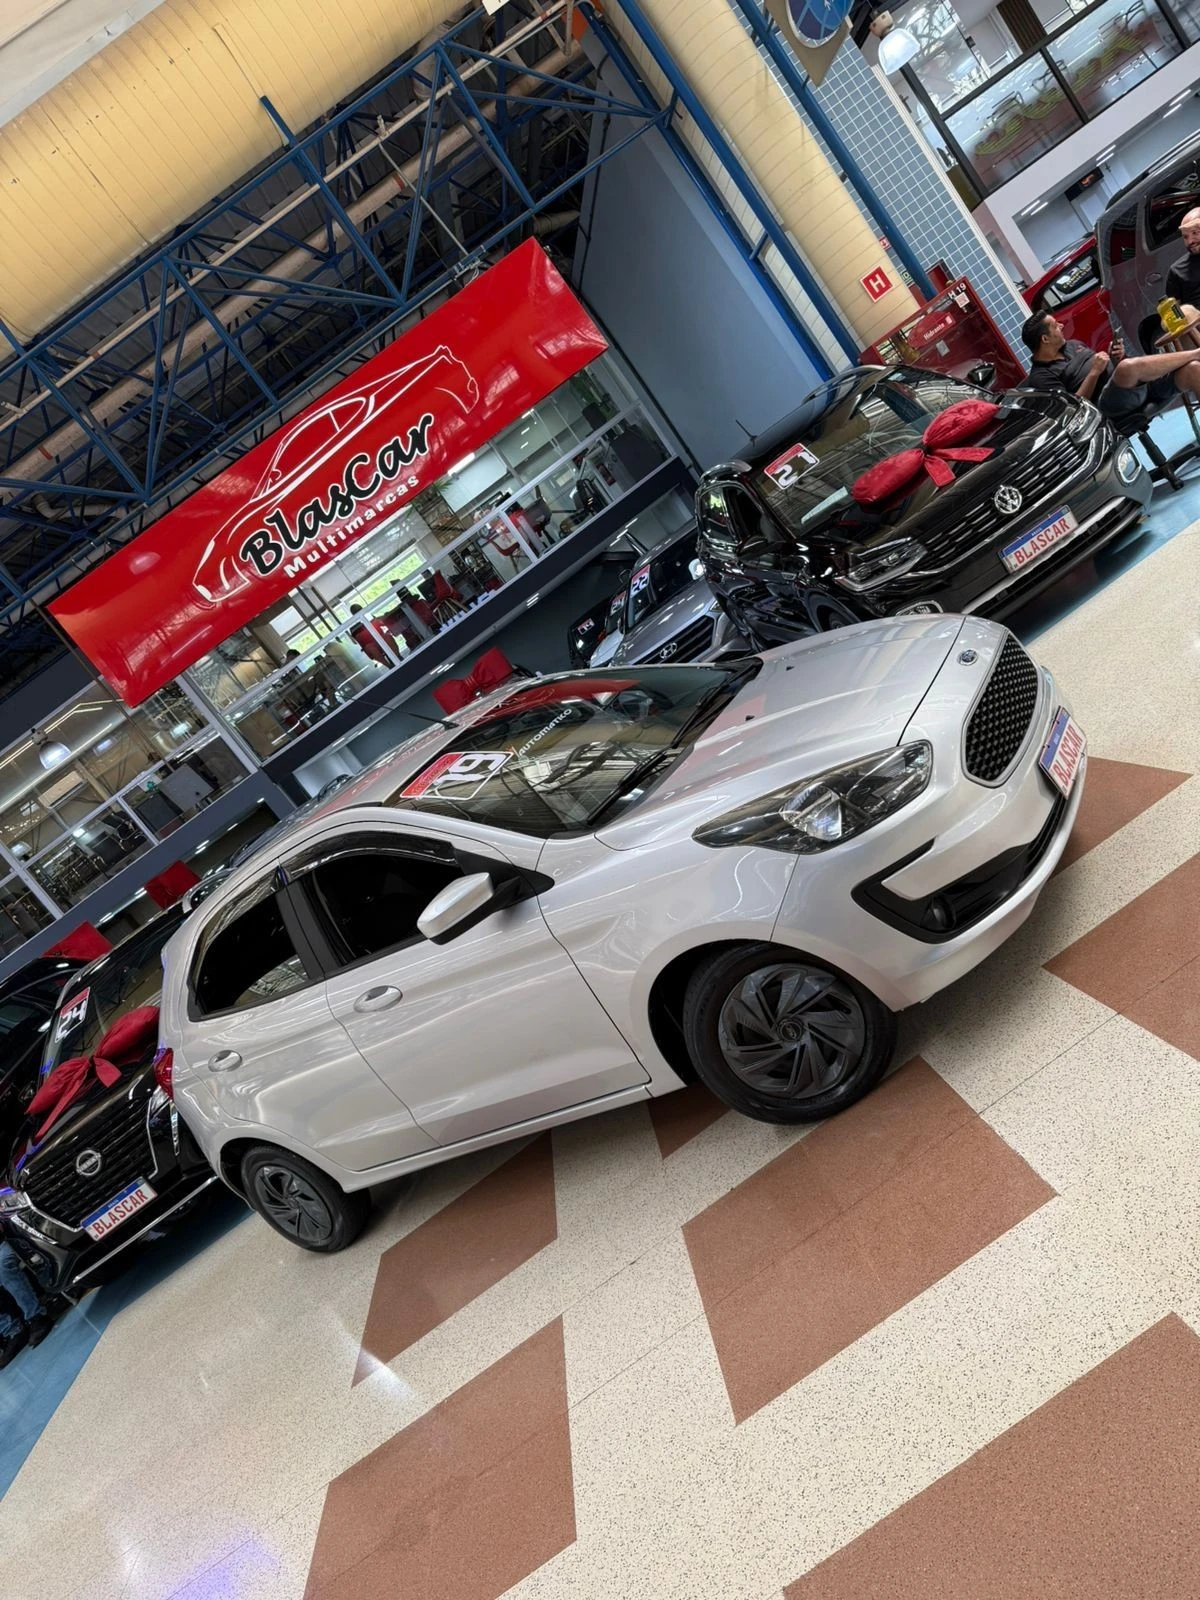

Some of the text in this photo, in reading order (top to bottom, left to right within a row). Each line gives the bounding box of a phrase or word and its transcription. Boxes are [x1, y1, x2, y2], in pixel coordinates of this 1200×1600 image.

[868, 273, 886, 293] H
[947, 282, 967, 299] H 19
[923, 323, 945, 340] Hidrante
[773, 451, 816, 487] 21
[239, 413, 434, 576] BlasCar
[283, 475, 420, 579] Multimarcas
[1013, 517, 1070, 564] BLASCAR
[632, 573, 649, 595] 22
[435, 753, 507, 784] 19
[1052, 724, 1084, 787] BLASCAR
[56, 1000, 88, 1039] 24
[92, 1188, 149, 1237] BLASCAR
